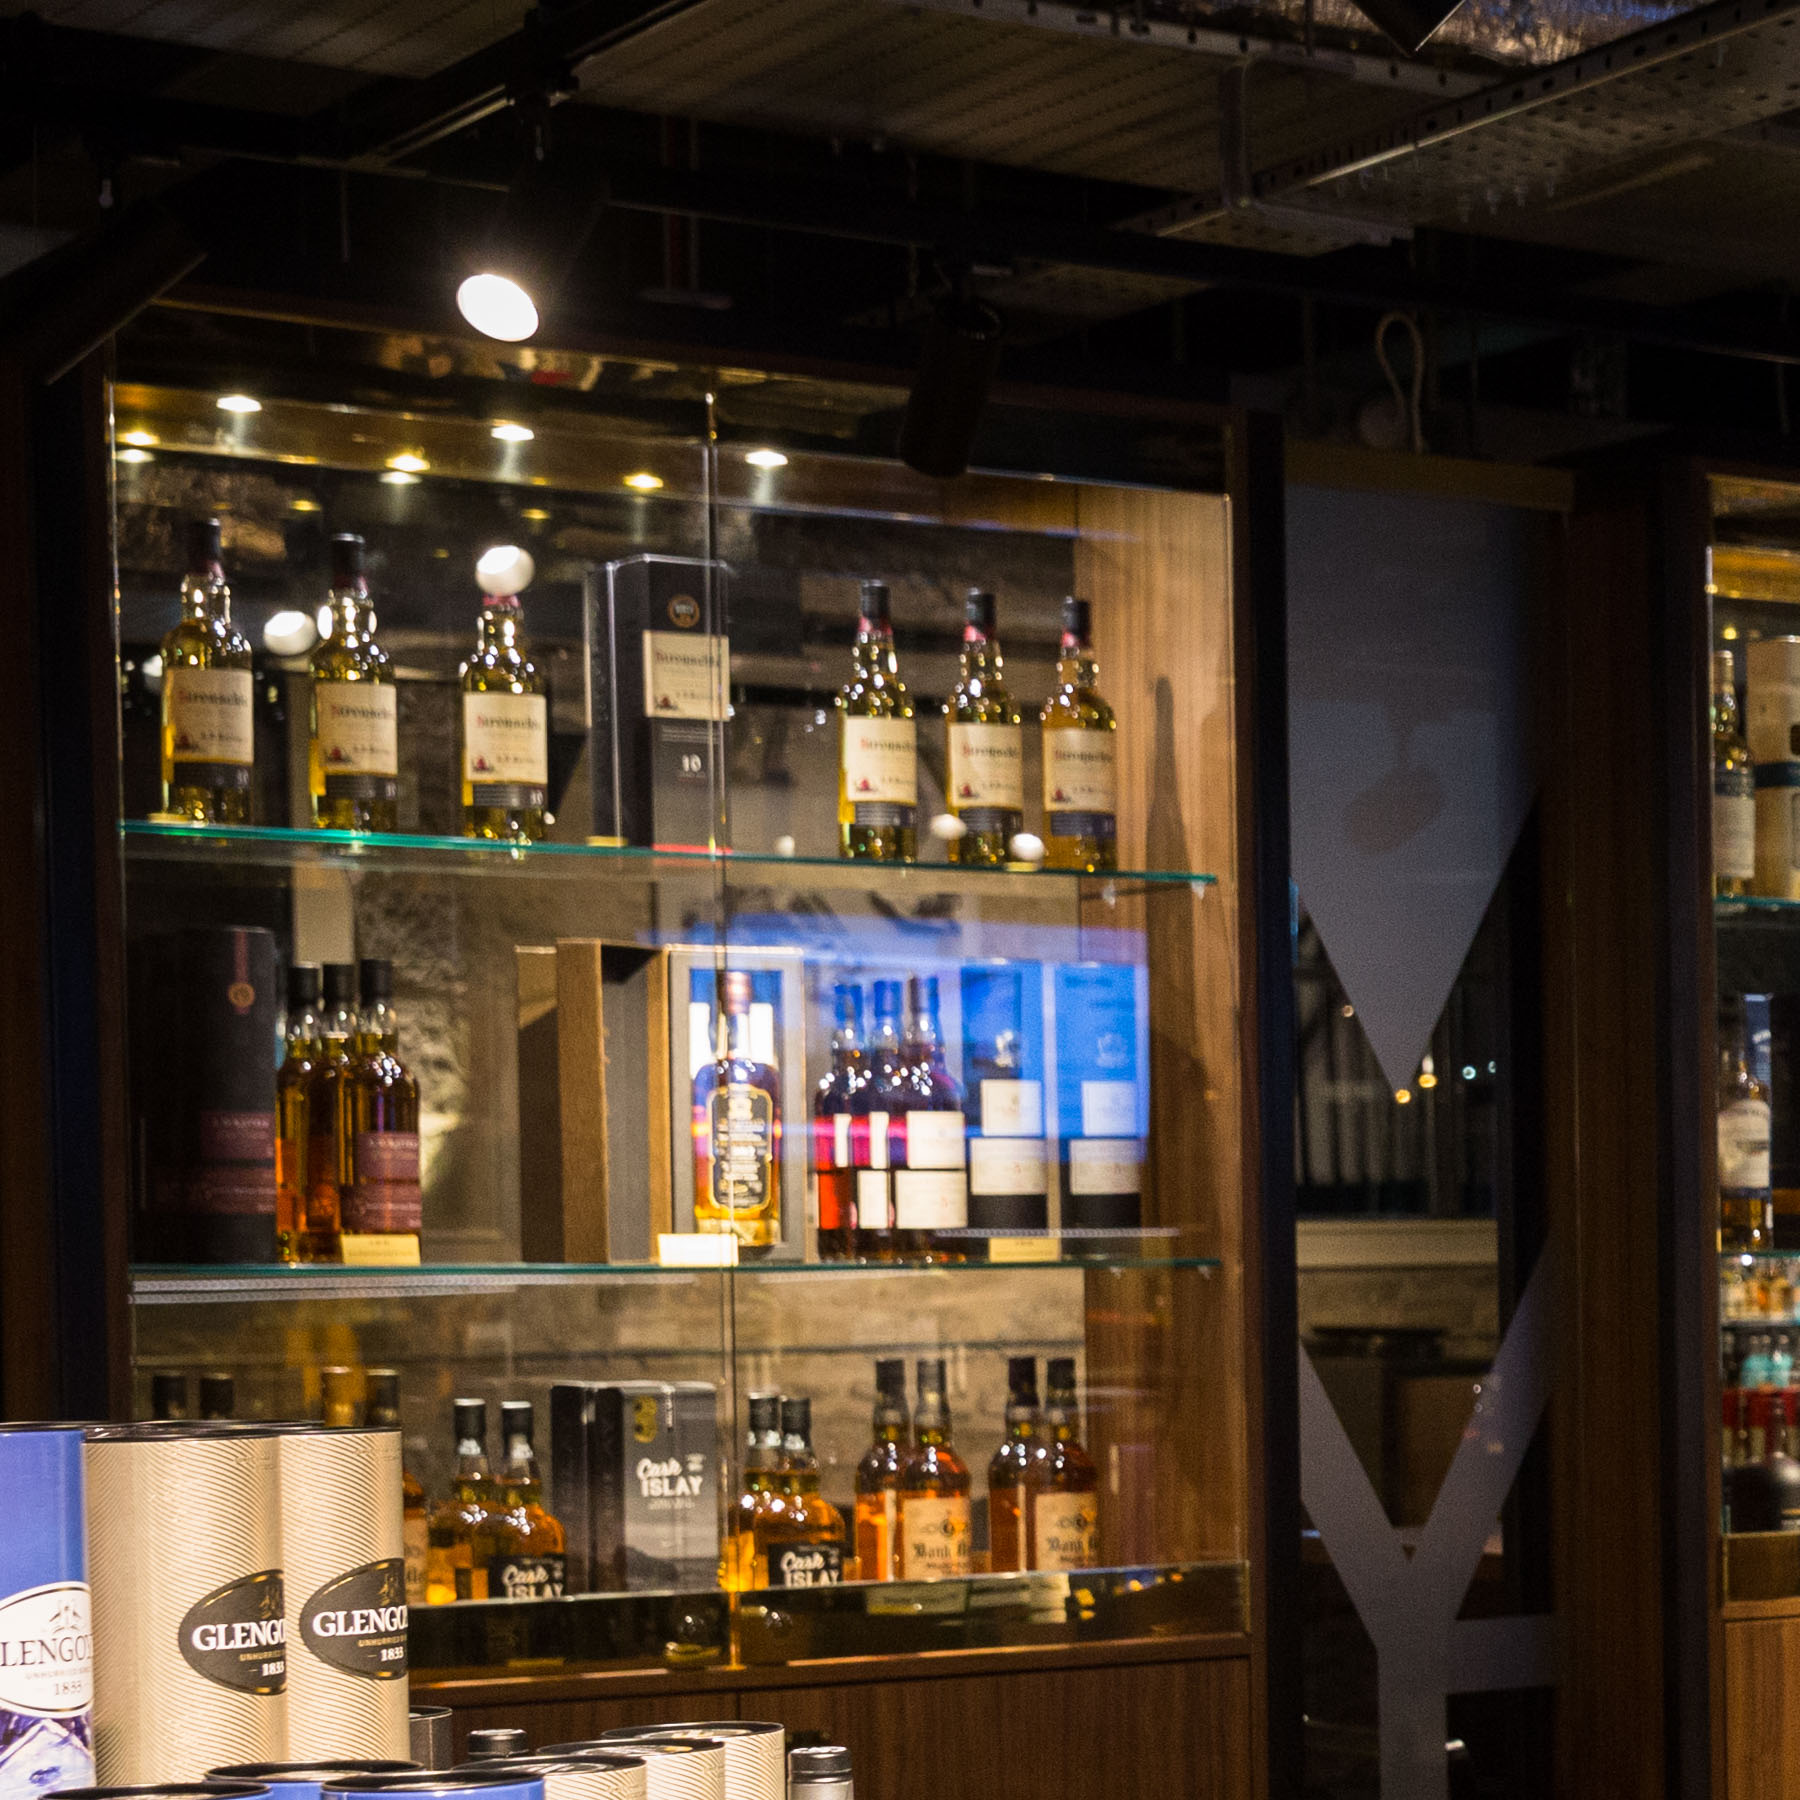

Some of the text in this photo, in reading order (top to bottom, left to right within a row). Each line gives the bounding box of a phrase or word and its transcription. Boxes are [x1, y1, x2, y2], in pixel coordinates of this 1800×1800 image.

[636, 1456, 683, 1480] Cask
[641, 1474, 703, 1498] ISLAY
[381, 1646, 404, 1662] 1833
[54, 1681, 82, 1696] 1833
